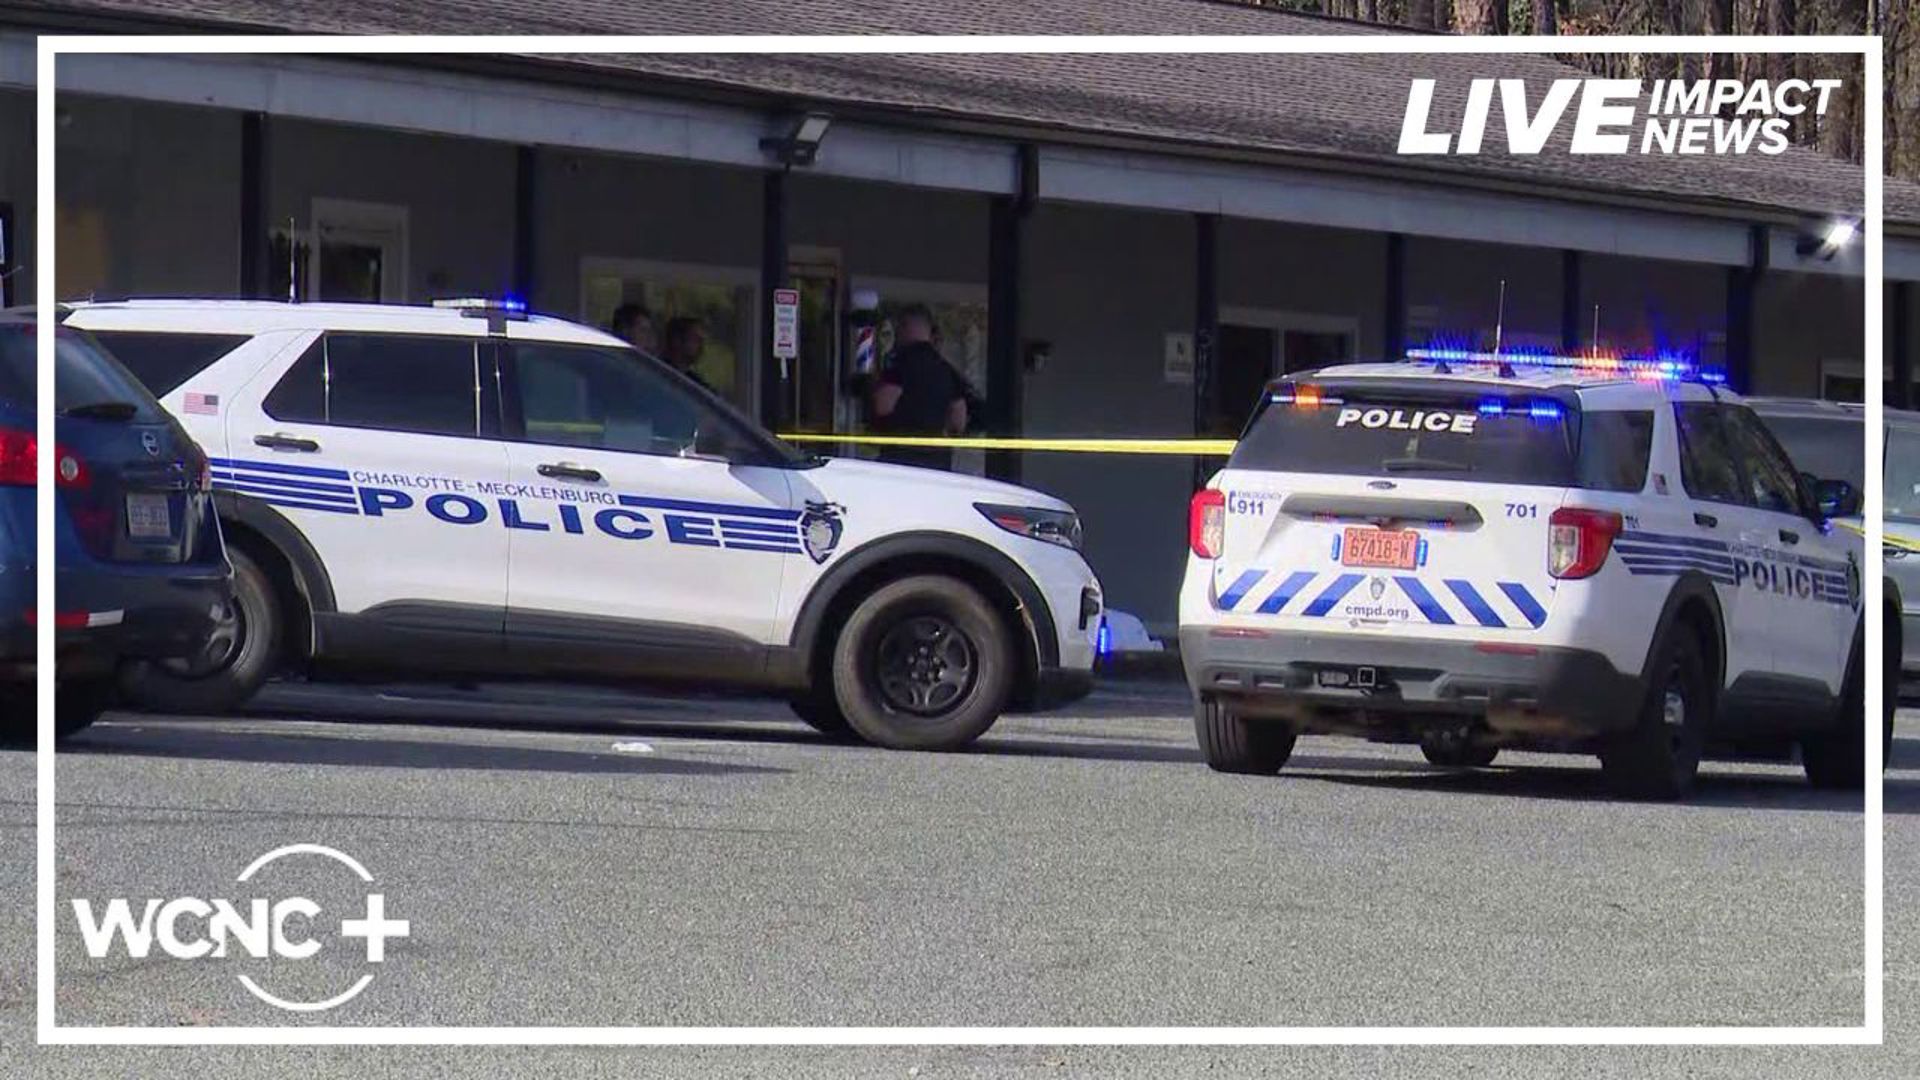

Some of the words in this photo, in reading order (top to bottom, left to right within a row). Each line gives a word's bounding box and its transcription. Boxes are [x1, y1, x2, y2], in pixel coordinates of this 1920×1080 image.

[1336, 408, 1478, 434] POLICE
[358, 486, 722, 548] POLICE
[1237, 499, 1264, 516] 911
[1505, 503, 1538, 519] 701
[1734, 557, 1826, 603] POLICE
[1345, 604, 1410, 619] cmpd.org
